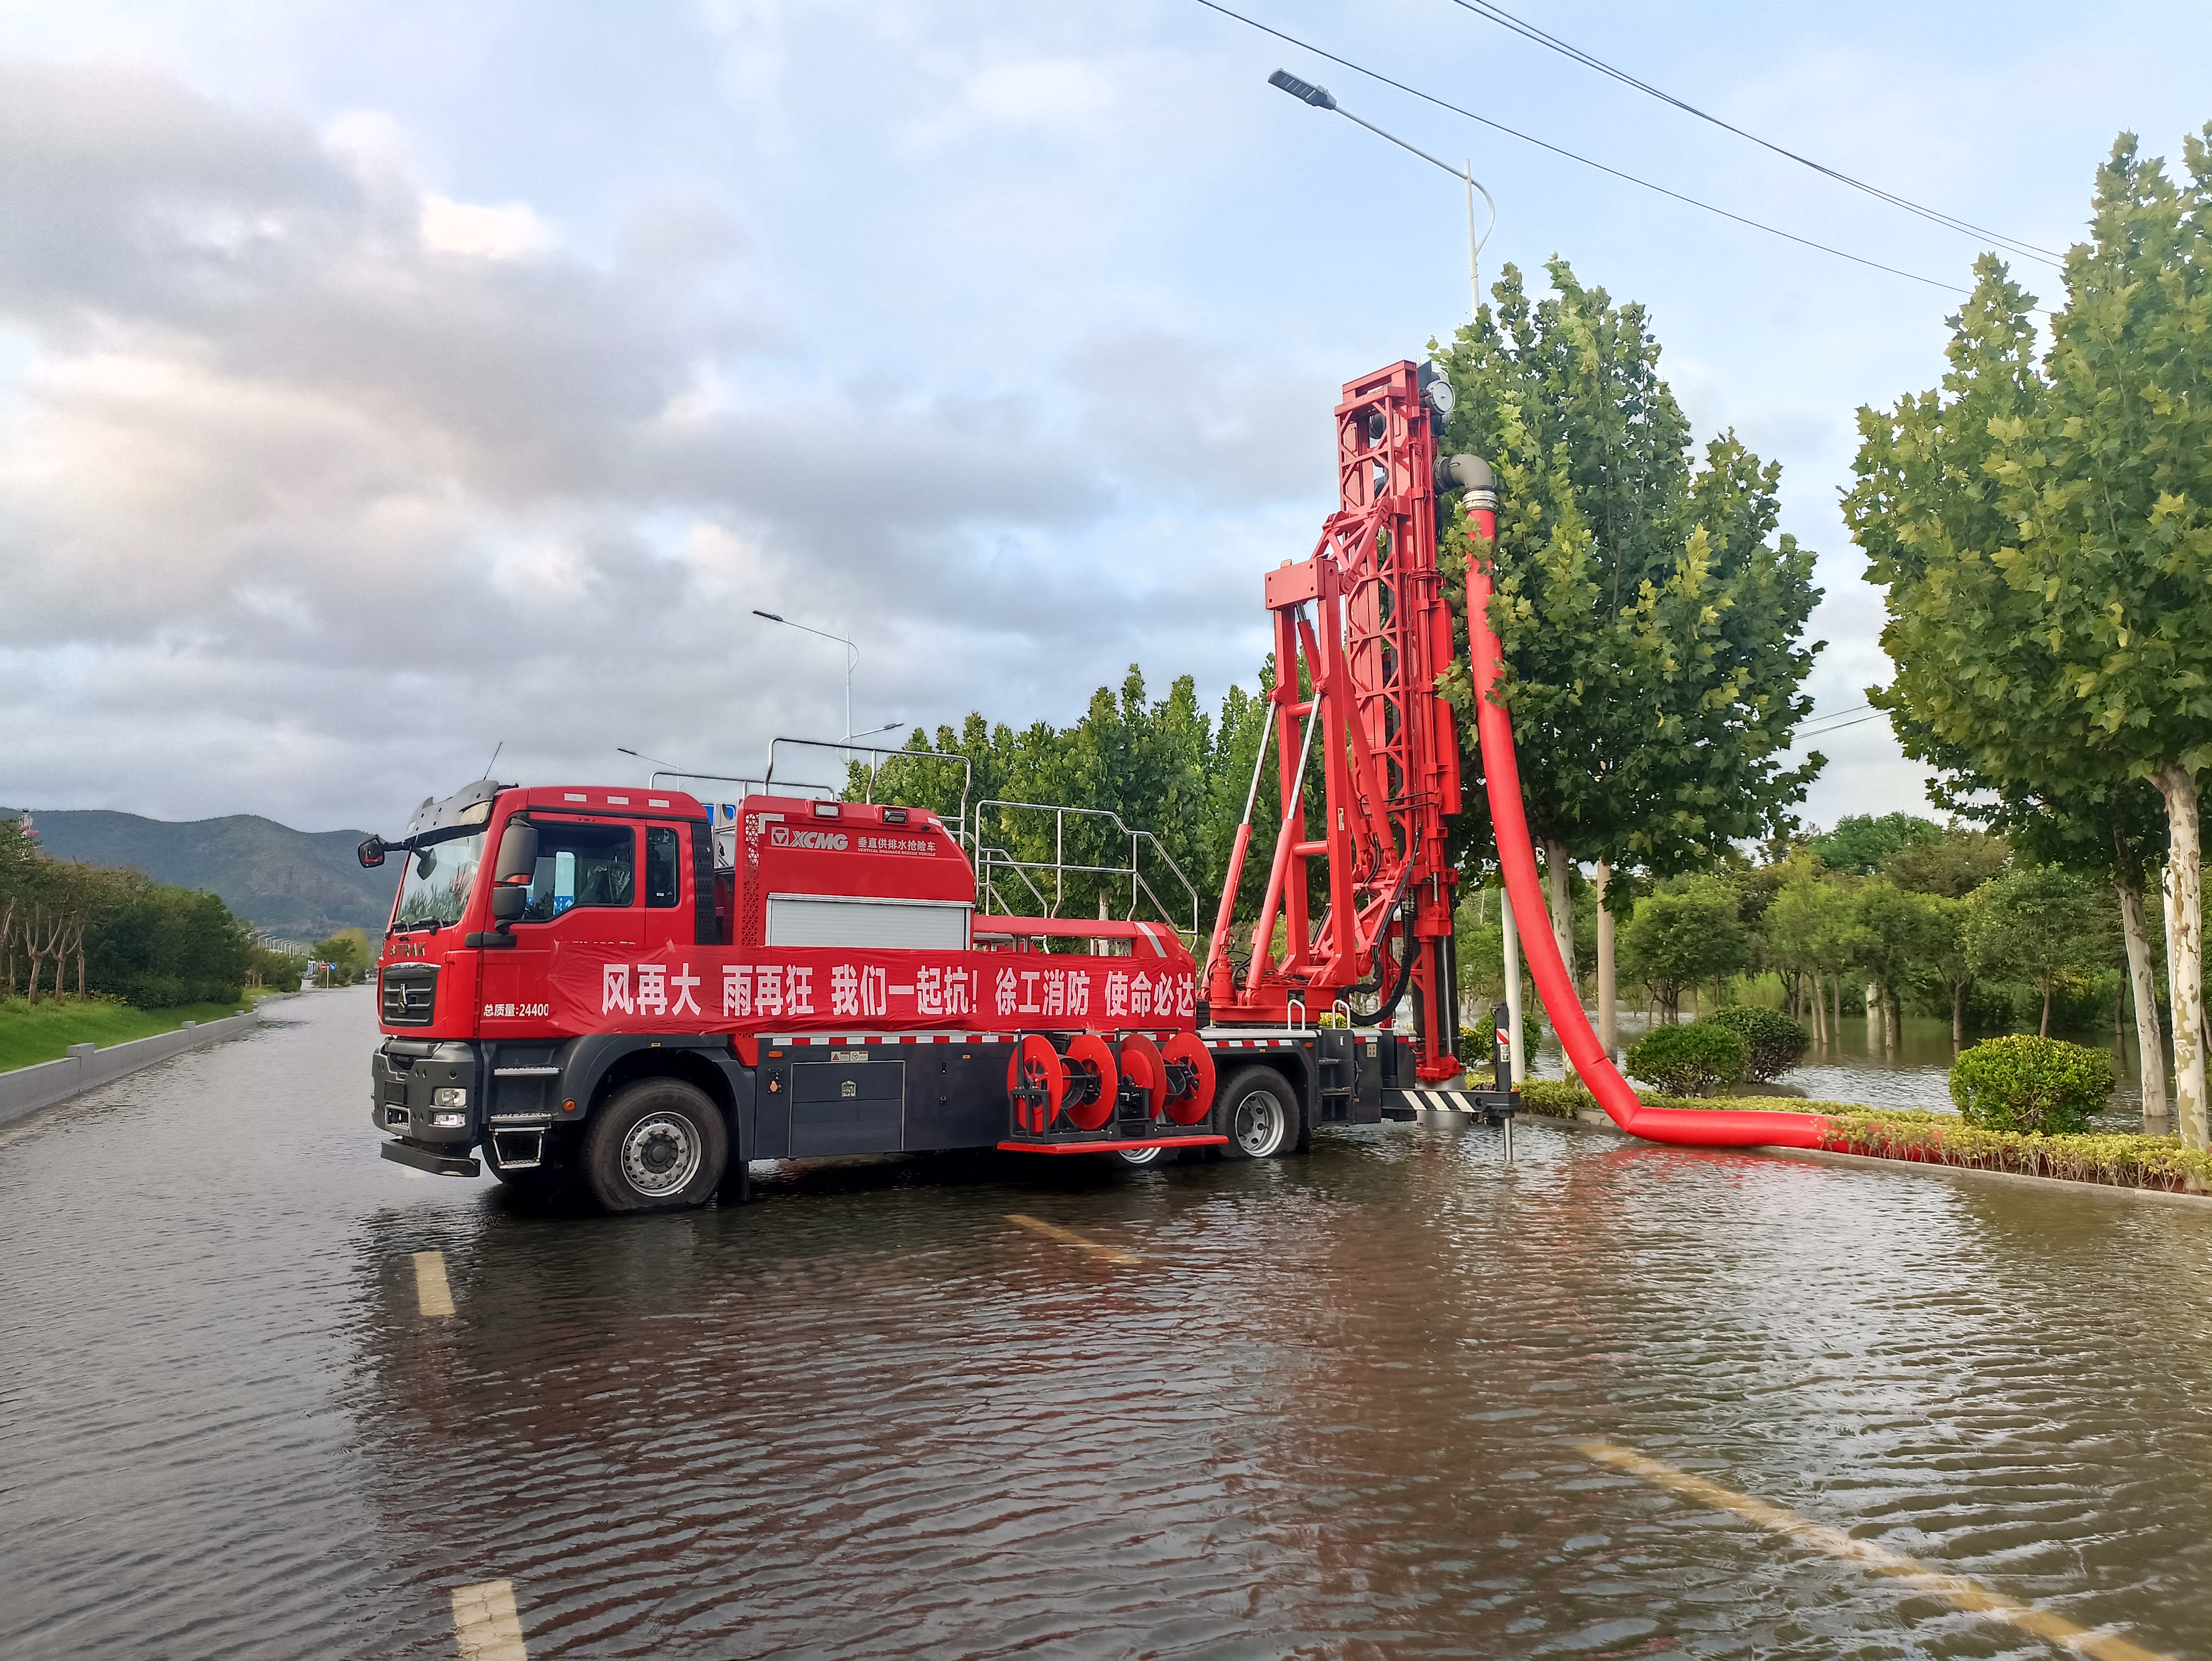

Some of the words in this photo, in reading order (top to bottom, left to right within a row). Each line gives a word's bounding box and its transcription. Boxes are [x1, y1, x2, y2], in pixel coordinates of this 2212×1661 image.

[788, 830, 848, 851] XCMG
[858, 837, 936, 852] 垂直供排水抢险车
[602, 963, 701, 1016] 风再大
[722, 963, 814, 1017] 雨再狂
[831, 963, 978, 1016] 我们一起抗!
[995, 967, 1090, 1016] 徐工消防
[1105, 970, 1195, 1017] 使命必达
[483, 1003, 549, 1017] 总质量:24400
